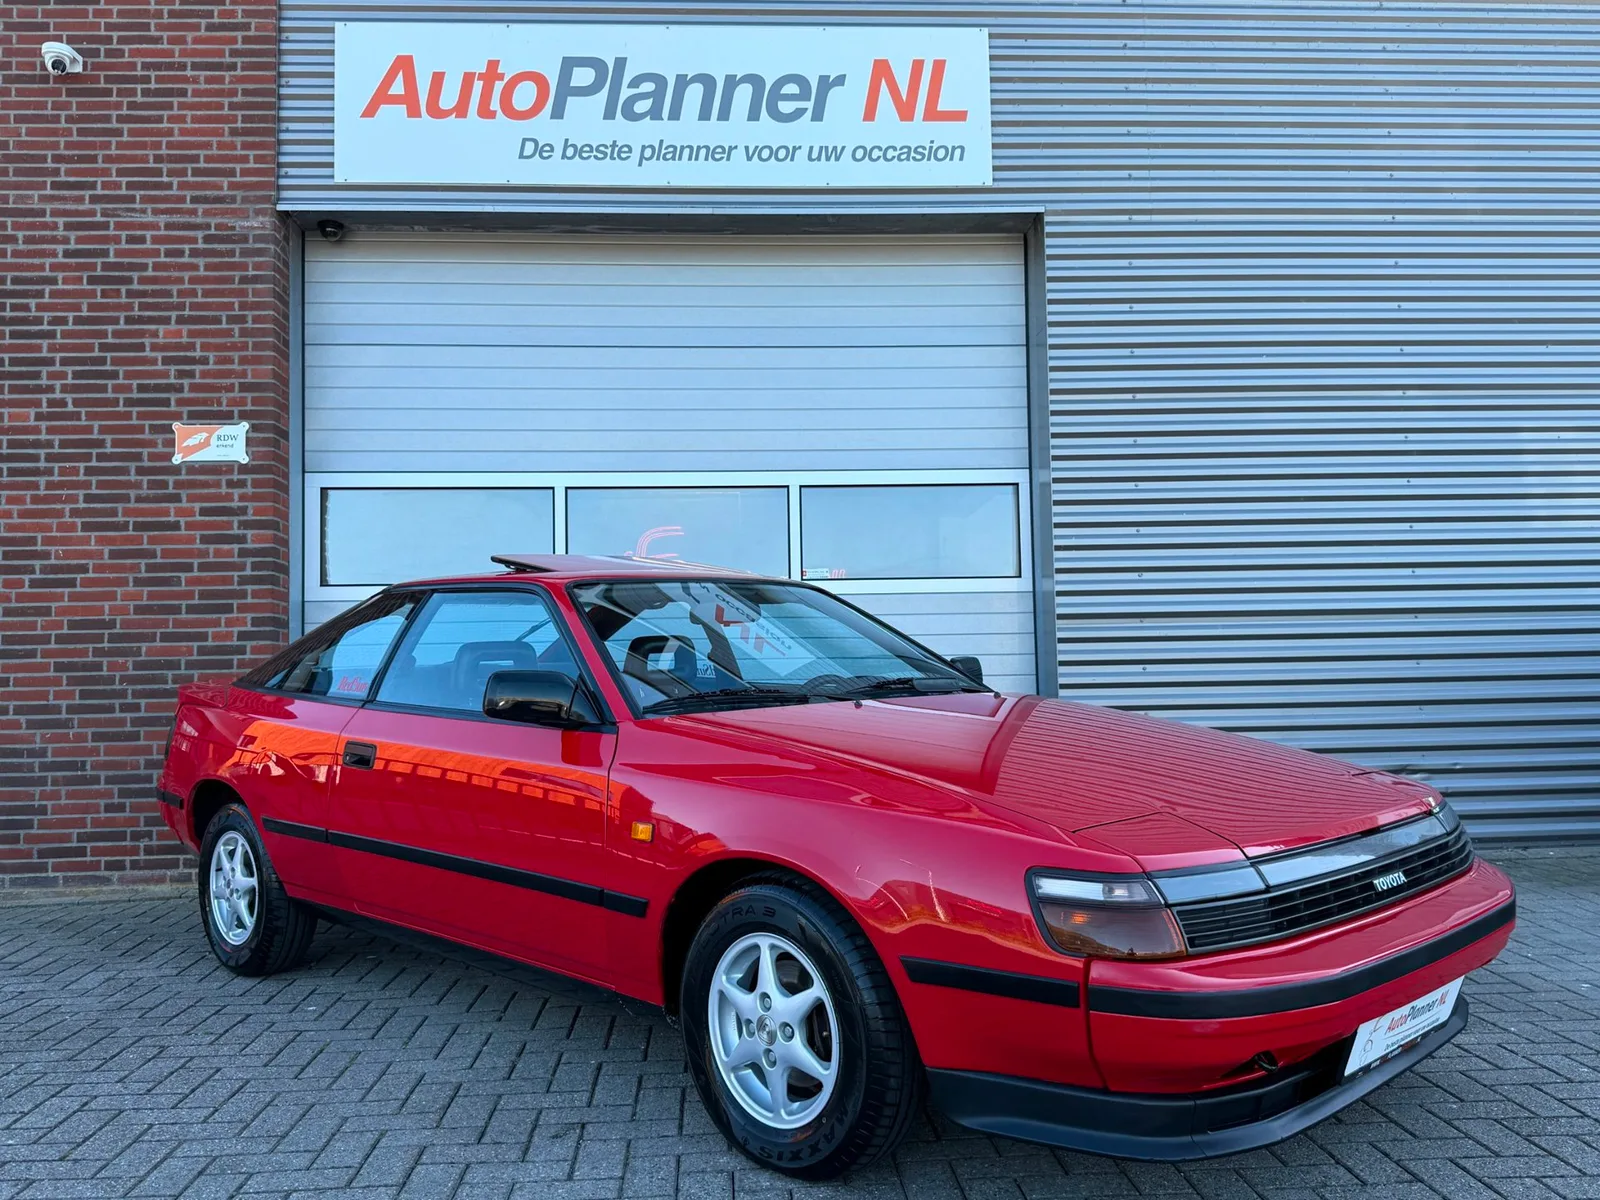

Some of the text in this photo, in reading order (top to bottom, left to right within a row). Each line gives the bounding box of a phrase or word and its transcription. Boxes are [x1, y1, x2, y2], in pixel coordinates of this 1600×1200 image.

[359, 54, 969, 123] AutoPlanner NL
[518, 137, 966, 167] De beste planner voor uw occasion
[1373, 871, 1408, 891] TOYOTA
[1384, 998, 1438, 1035] AutoPlanner
[758, 1097, 849, 1161] MAXXIS
